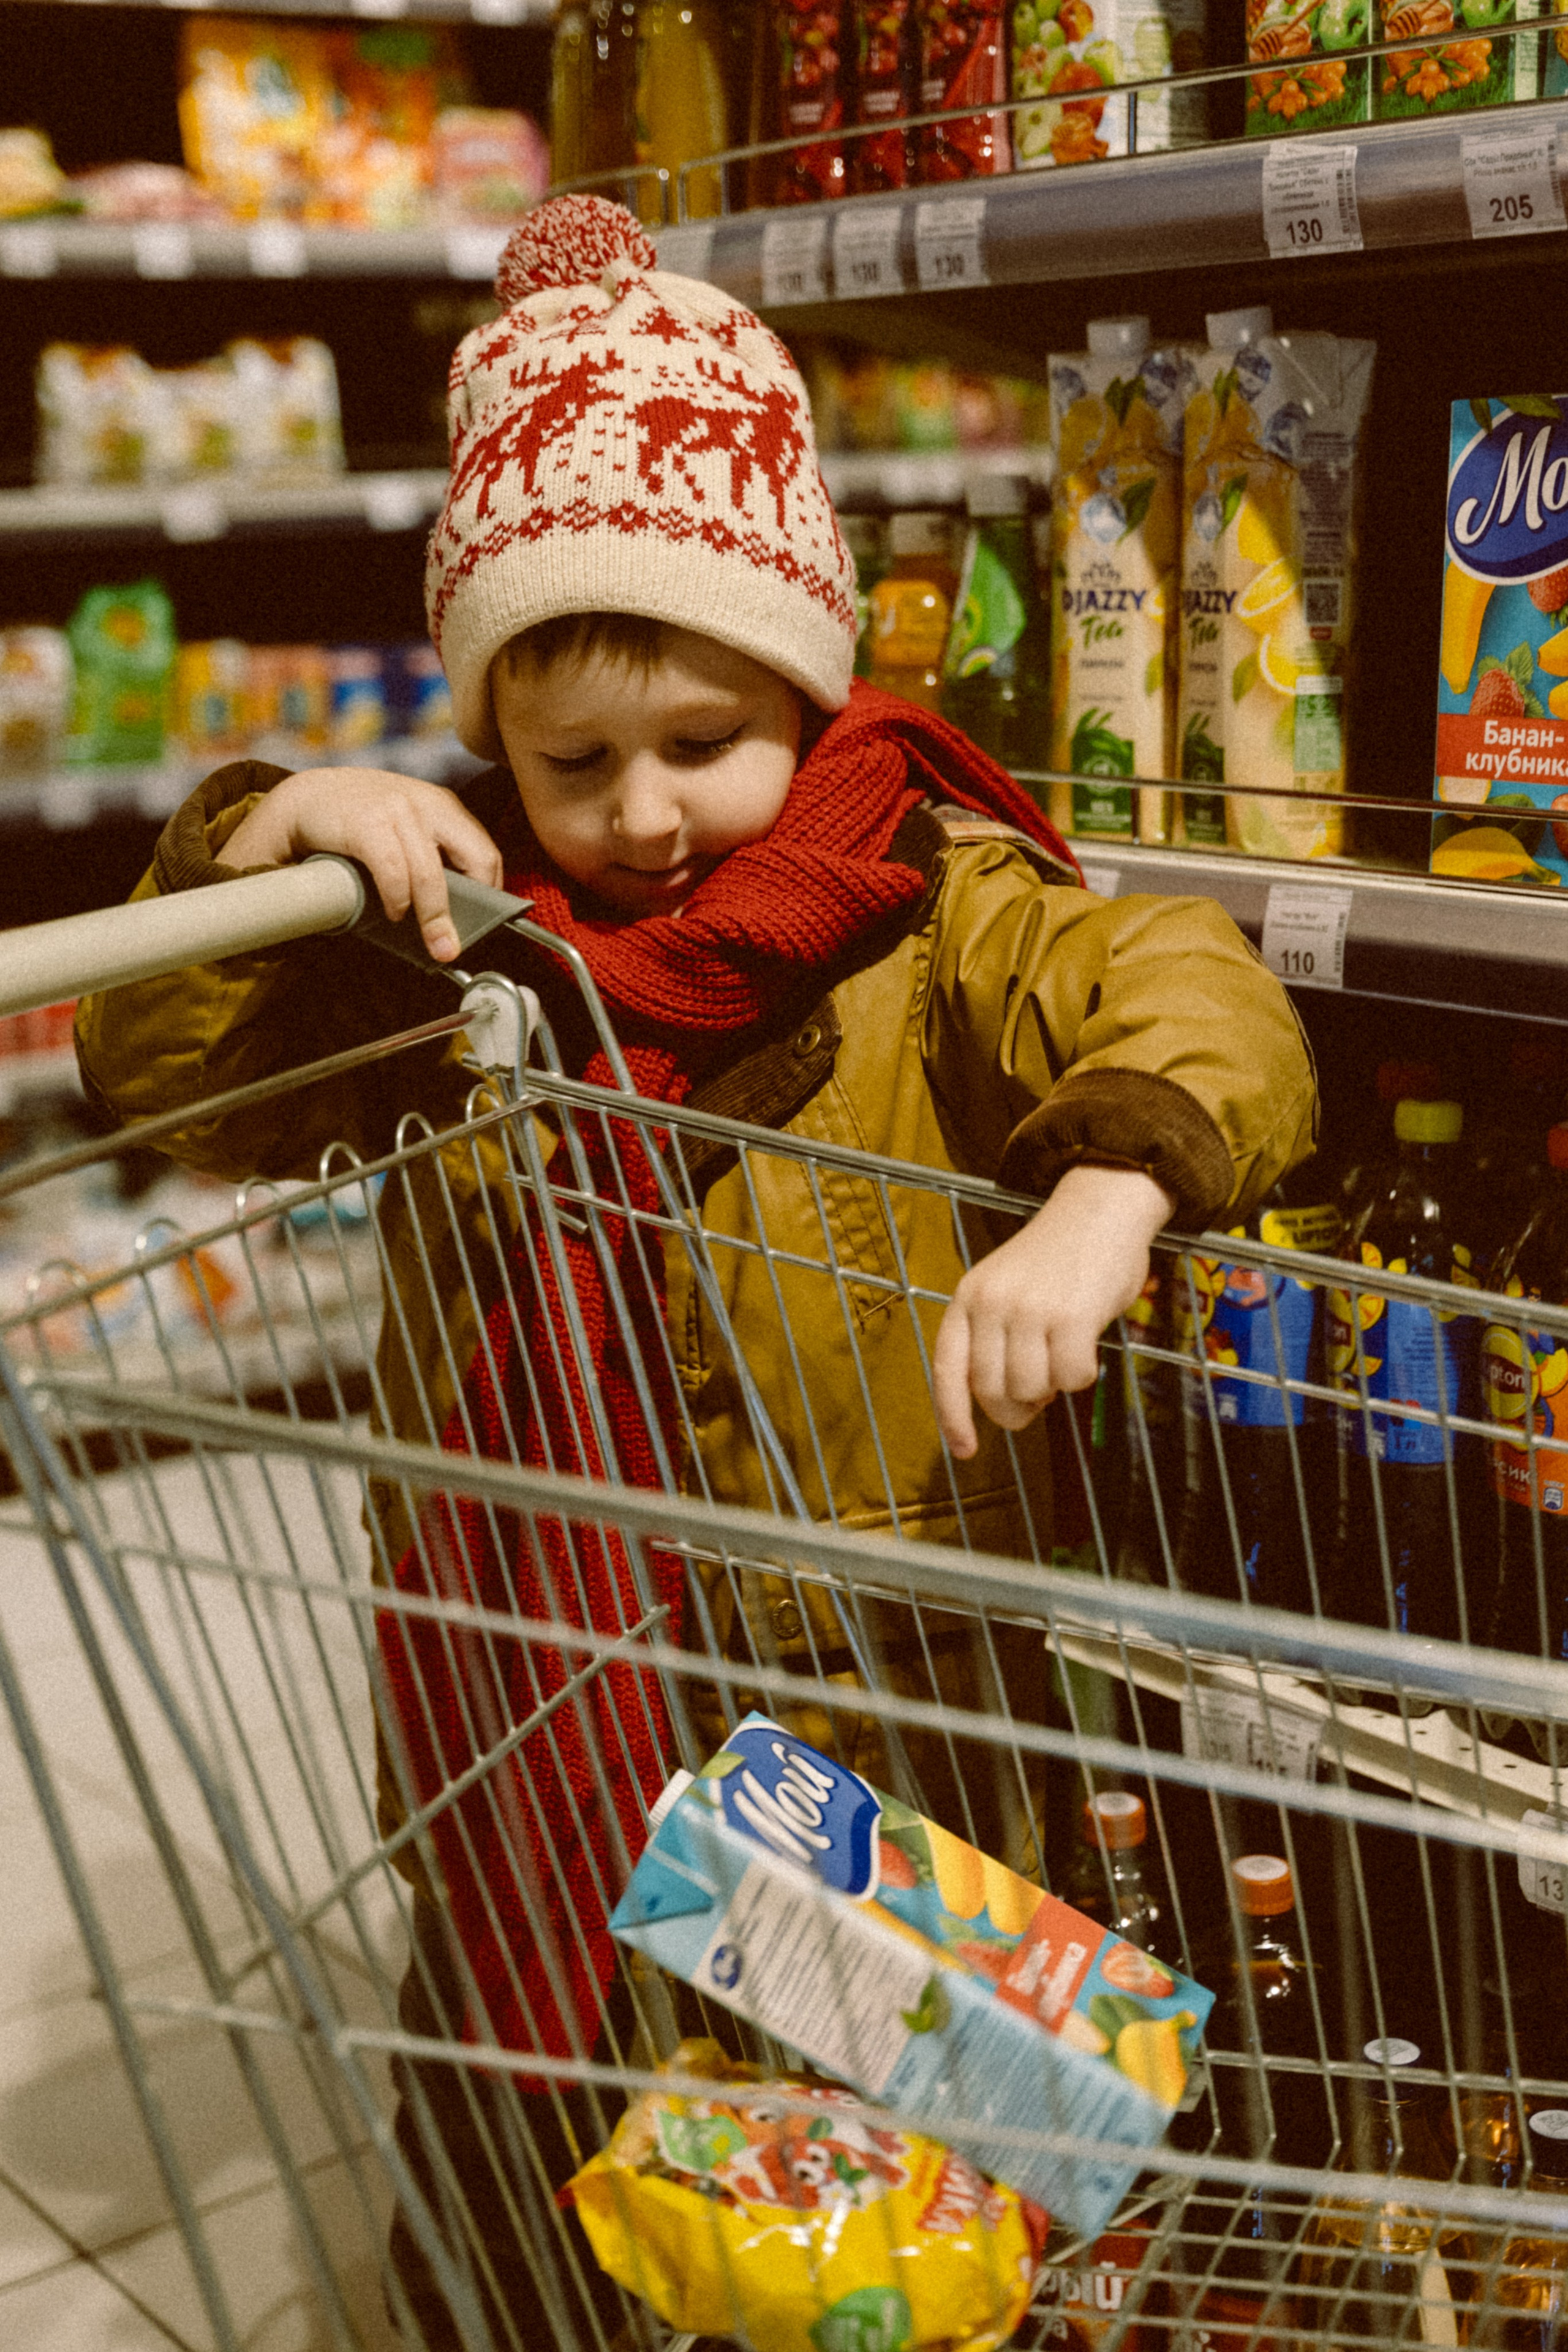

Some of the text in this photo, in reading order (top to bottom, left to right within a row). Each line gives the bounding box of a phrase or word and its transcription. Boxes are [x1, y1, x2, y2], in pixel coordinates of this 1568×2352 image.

[1490, 194, 1534, 222] 205
[1286, 218, 1323, 244] 130
[1483, 719, 1565, 748] Банан-
[1465, 748, 1568, 778] клубник
[1281, 949, 1315, 974] 110
